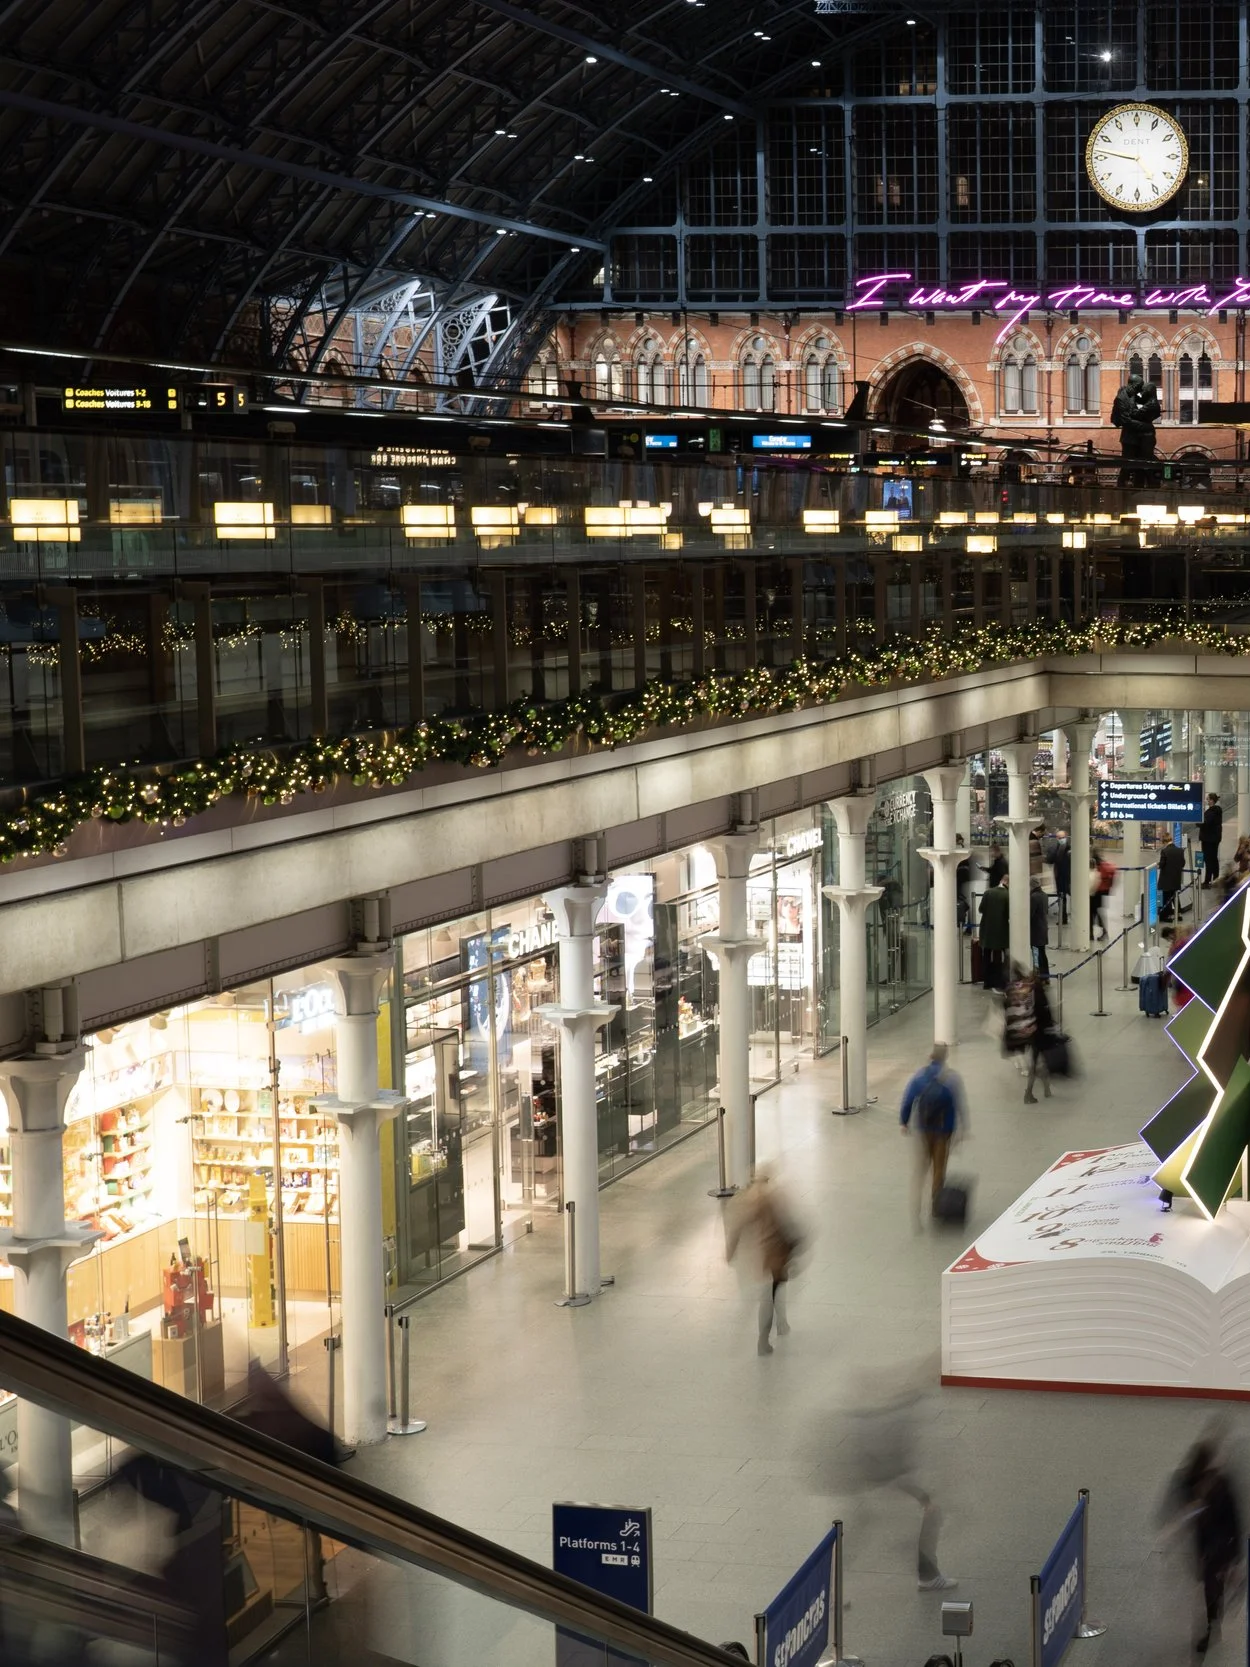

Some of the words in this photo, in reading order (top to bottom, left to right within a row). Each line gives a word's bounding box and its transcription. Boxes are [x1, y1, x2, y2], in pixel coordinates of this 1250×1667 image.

[846, 273, 912, 310] I
[995, 288, 1041, 344] my
[1047, 285, 1135, 308] time
[1145, 284, 1212, 306] with
[75, 400, 105, 408] Coaches
[106, 400, 135, 408] Voitures
[217, 392, 226, 406] 5
[238, 393, 244, 406] 5
[1110, 782, 1142, 790] Departures
[890, 790, 918, 810] CURRENCY
[787, 828, 824, 857] CHANEL
[1049, 1237, 1086, 1251] 8
[560, 1536, 617, 1550] Platforms
[620, 1541, 640, 1552] 1-4
